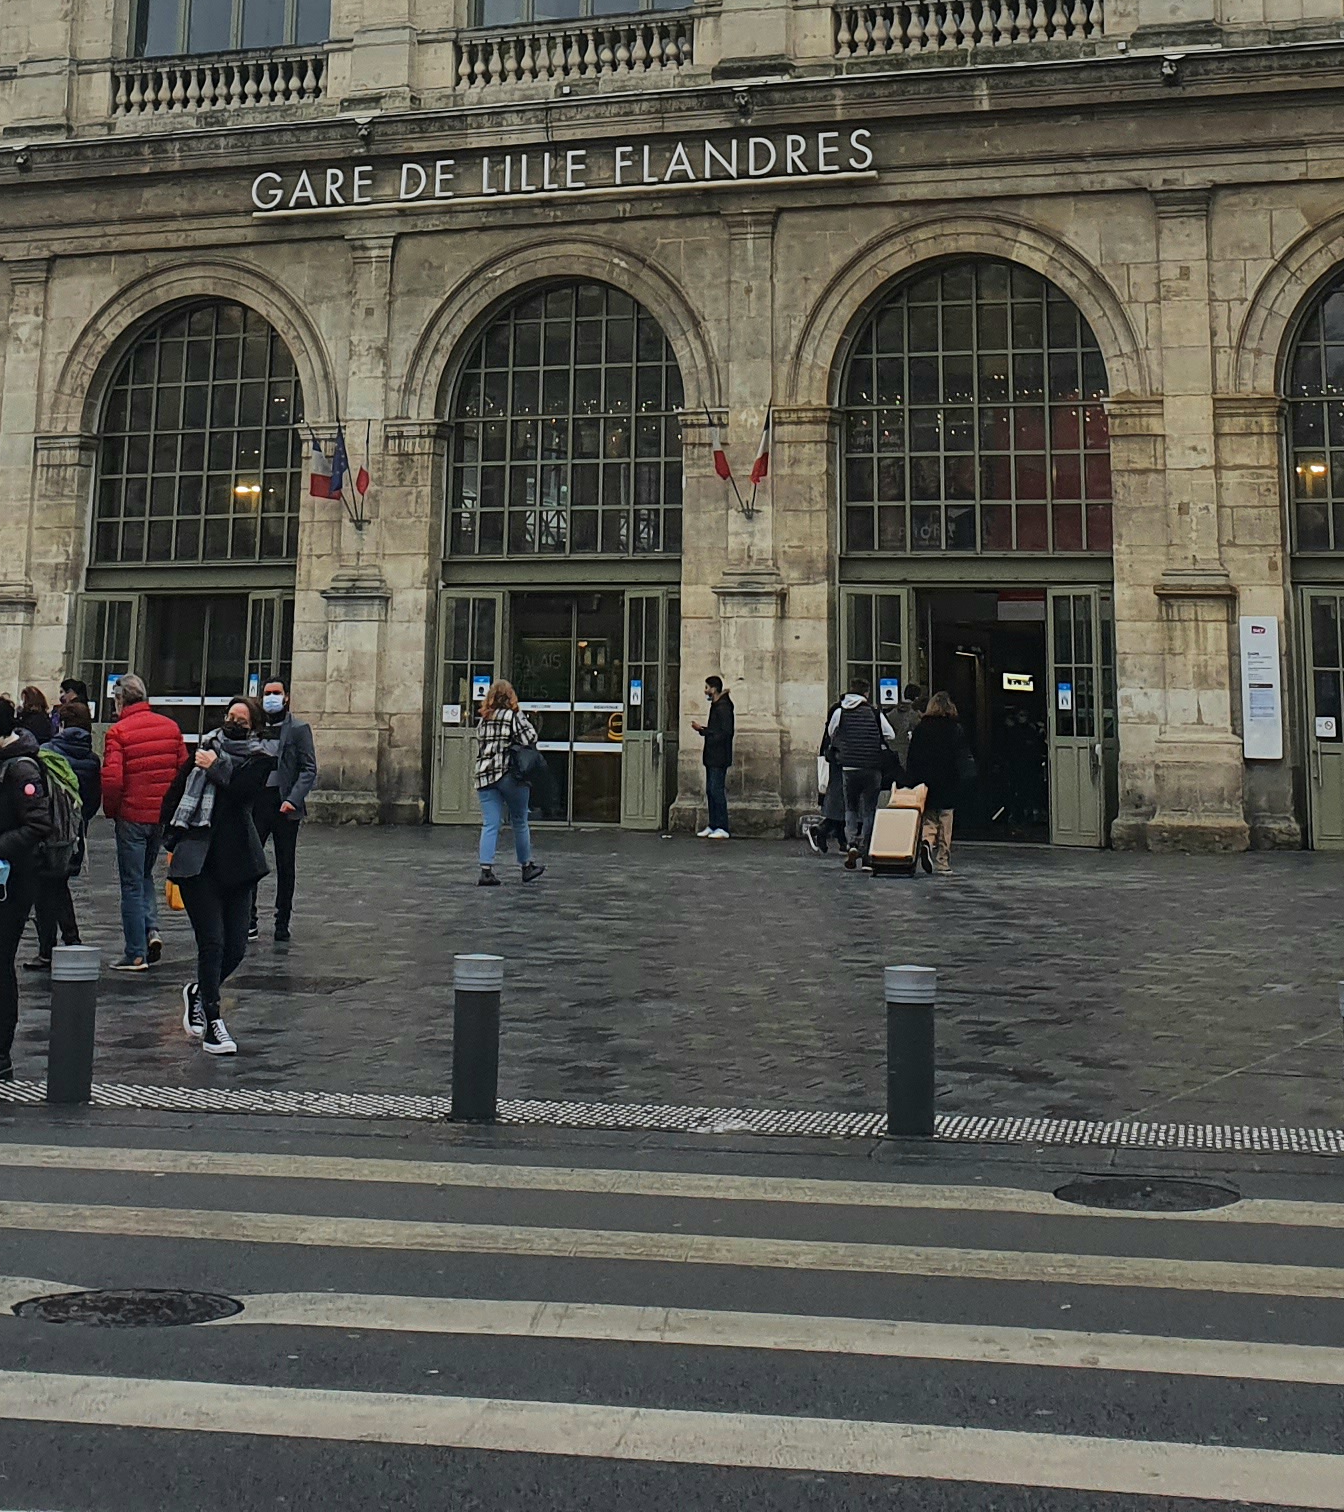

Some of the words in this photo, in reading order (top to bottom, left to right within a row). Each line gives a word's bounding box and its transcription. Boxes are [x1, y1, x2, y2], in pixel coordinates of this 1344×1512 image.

[251, 165, 373, 210] GARE
[399, 159, 455, 200] DE
[482, 149, 587, 195] LILLE
[614, 128, 874, 186] FLANDRES
